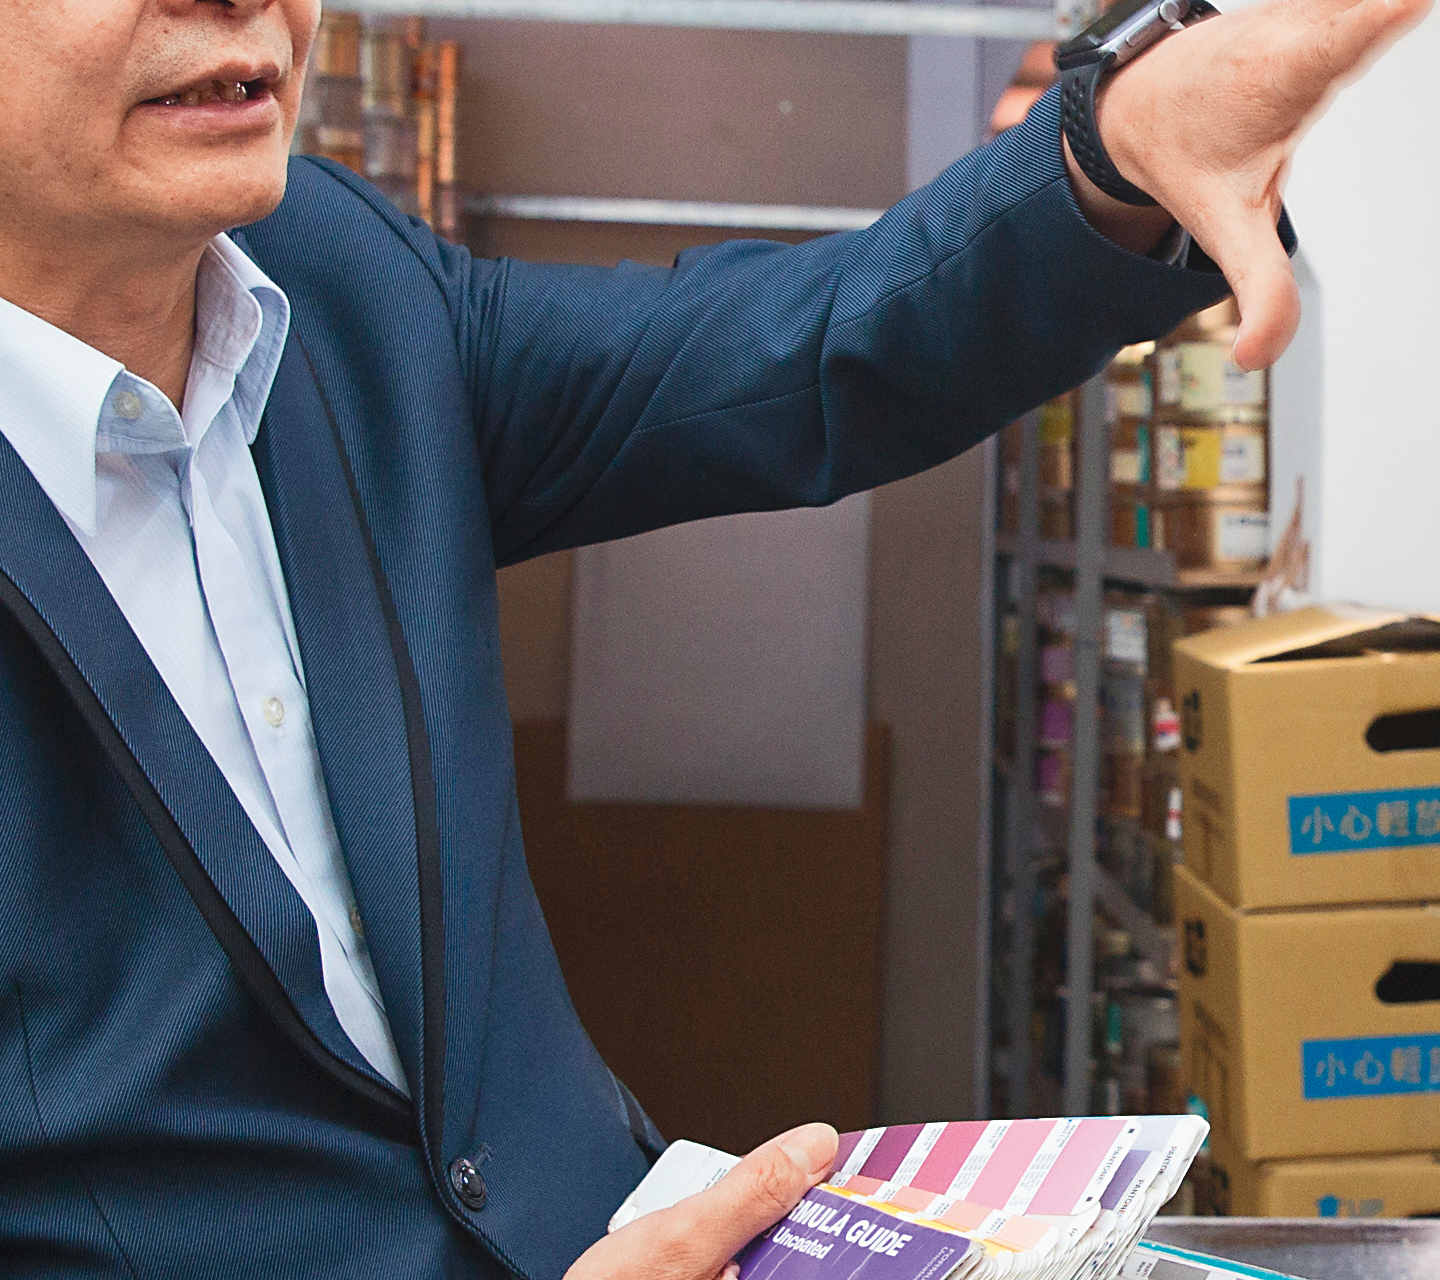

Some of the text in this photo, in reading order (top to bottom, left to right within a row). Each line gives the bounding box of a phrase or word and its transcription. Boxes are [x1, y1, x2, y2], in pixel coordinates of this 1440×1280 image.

[1096, 1145, 1122, 1184] PANTONE
[1160, 1145, 1178, 1176] PANTON
[1117, 1179, 1145, 1218] PANTONE
[772, 1226, 834, 1260] Uncoated
[788, 1200, 913, 1257] RMULA GUIDE
